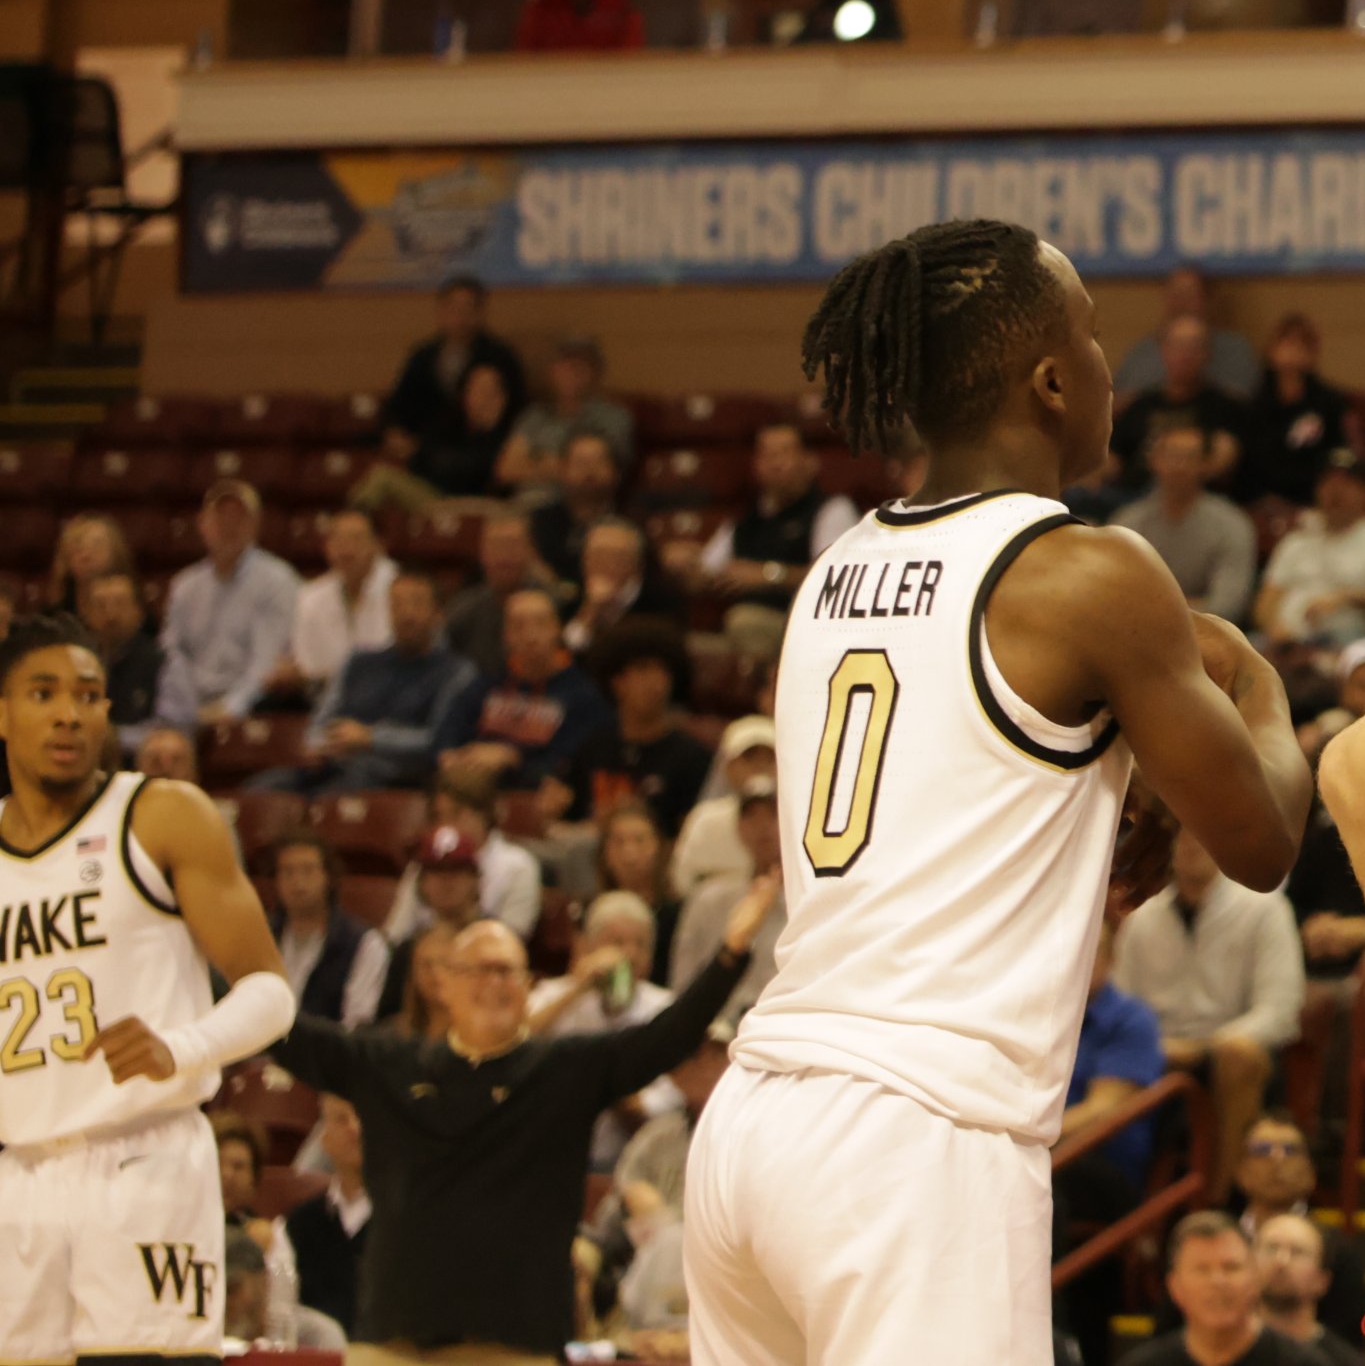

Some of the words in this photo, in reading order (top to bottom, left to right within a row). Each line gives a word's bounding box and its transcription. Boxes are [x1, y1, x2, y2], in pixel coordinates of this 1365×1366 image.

[516, 166, 801, 269] SHRINERS
[812, 153, 1164, 261] CHILDREN'S
[813, 560, 944, 620] MILLER
[803, 648, 900, 878] 0
[0, 966, 99, 1074] 23
[134, 1242, 217, 1322] WF
